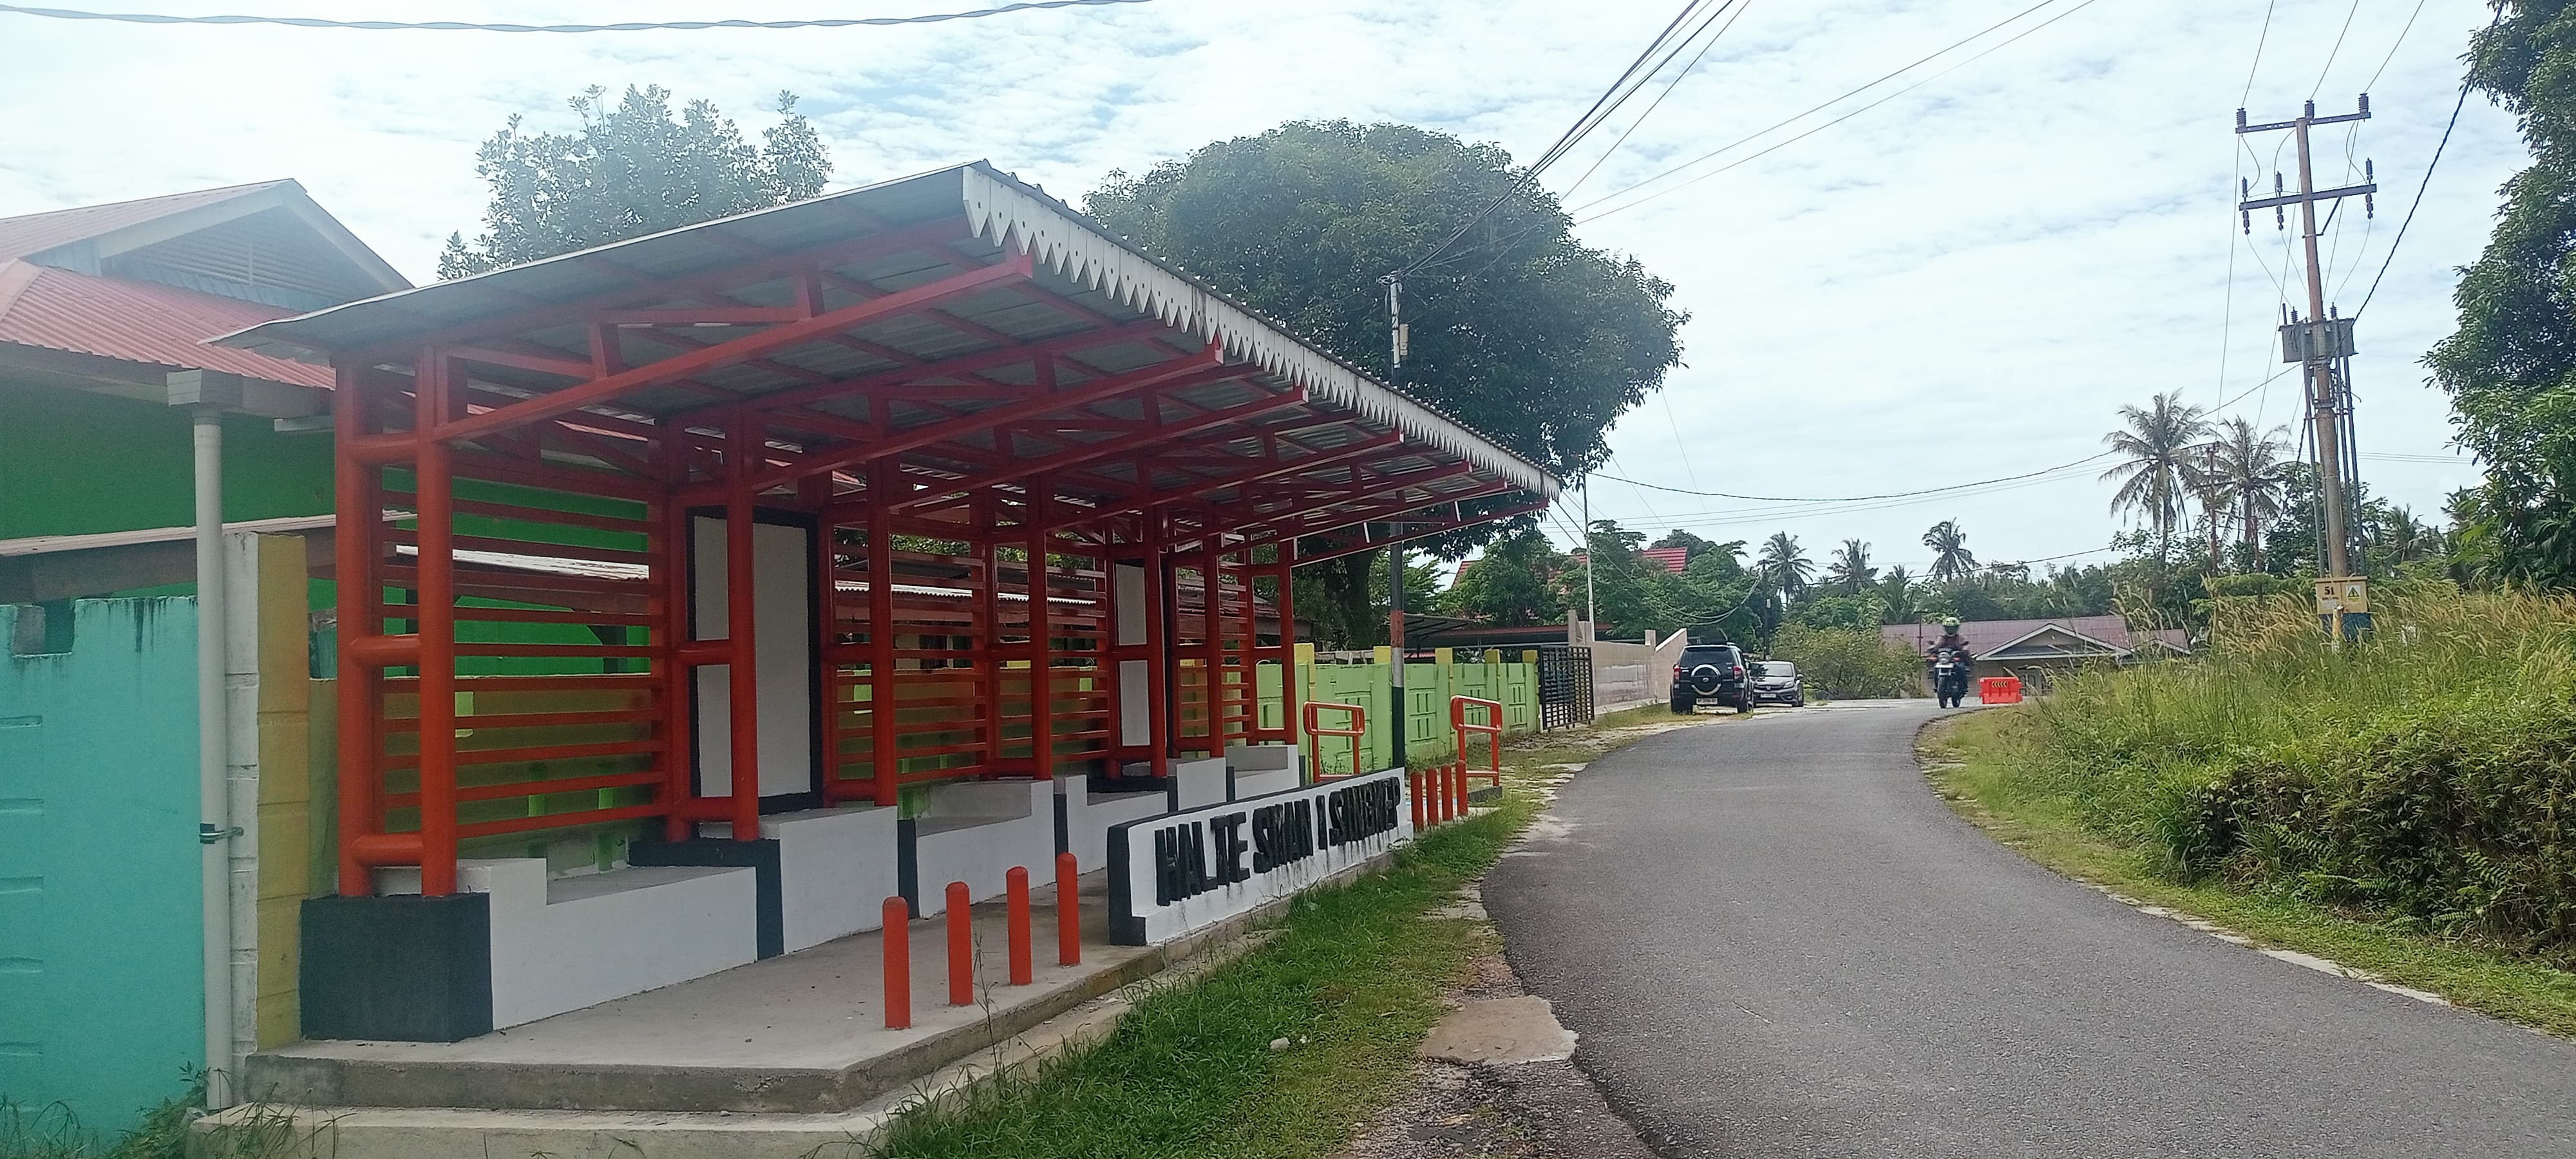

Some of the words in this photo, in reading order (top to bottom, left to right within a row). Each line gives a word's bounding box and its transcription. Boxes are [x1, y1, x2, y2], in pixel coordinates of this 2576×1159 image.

[2324, 586, 2334, 595] 51
[1155, 812, 1250, 907] HALTE
[1253, 799, 1314, 874] SMAN
